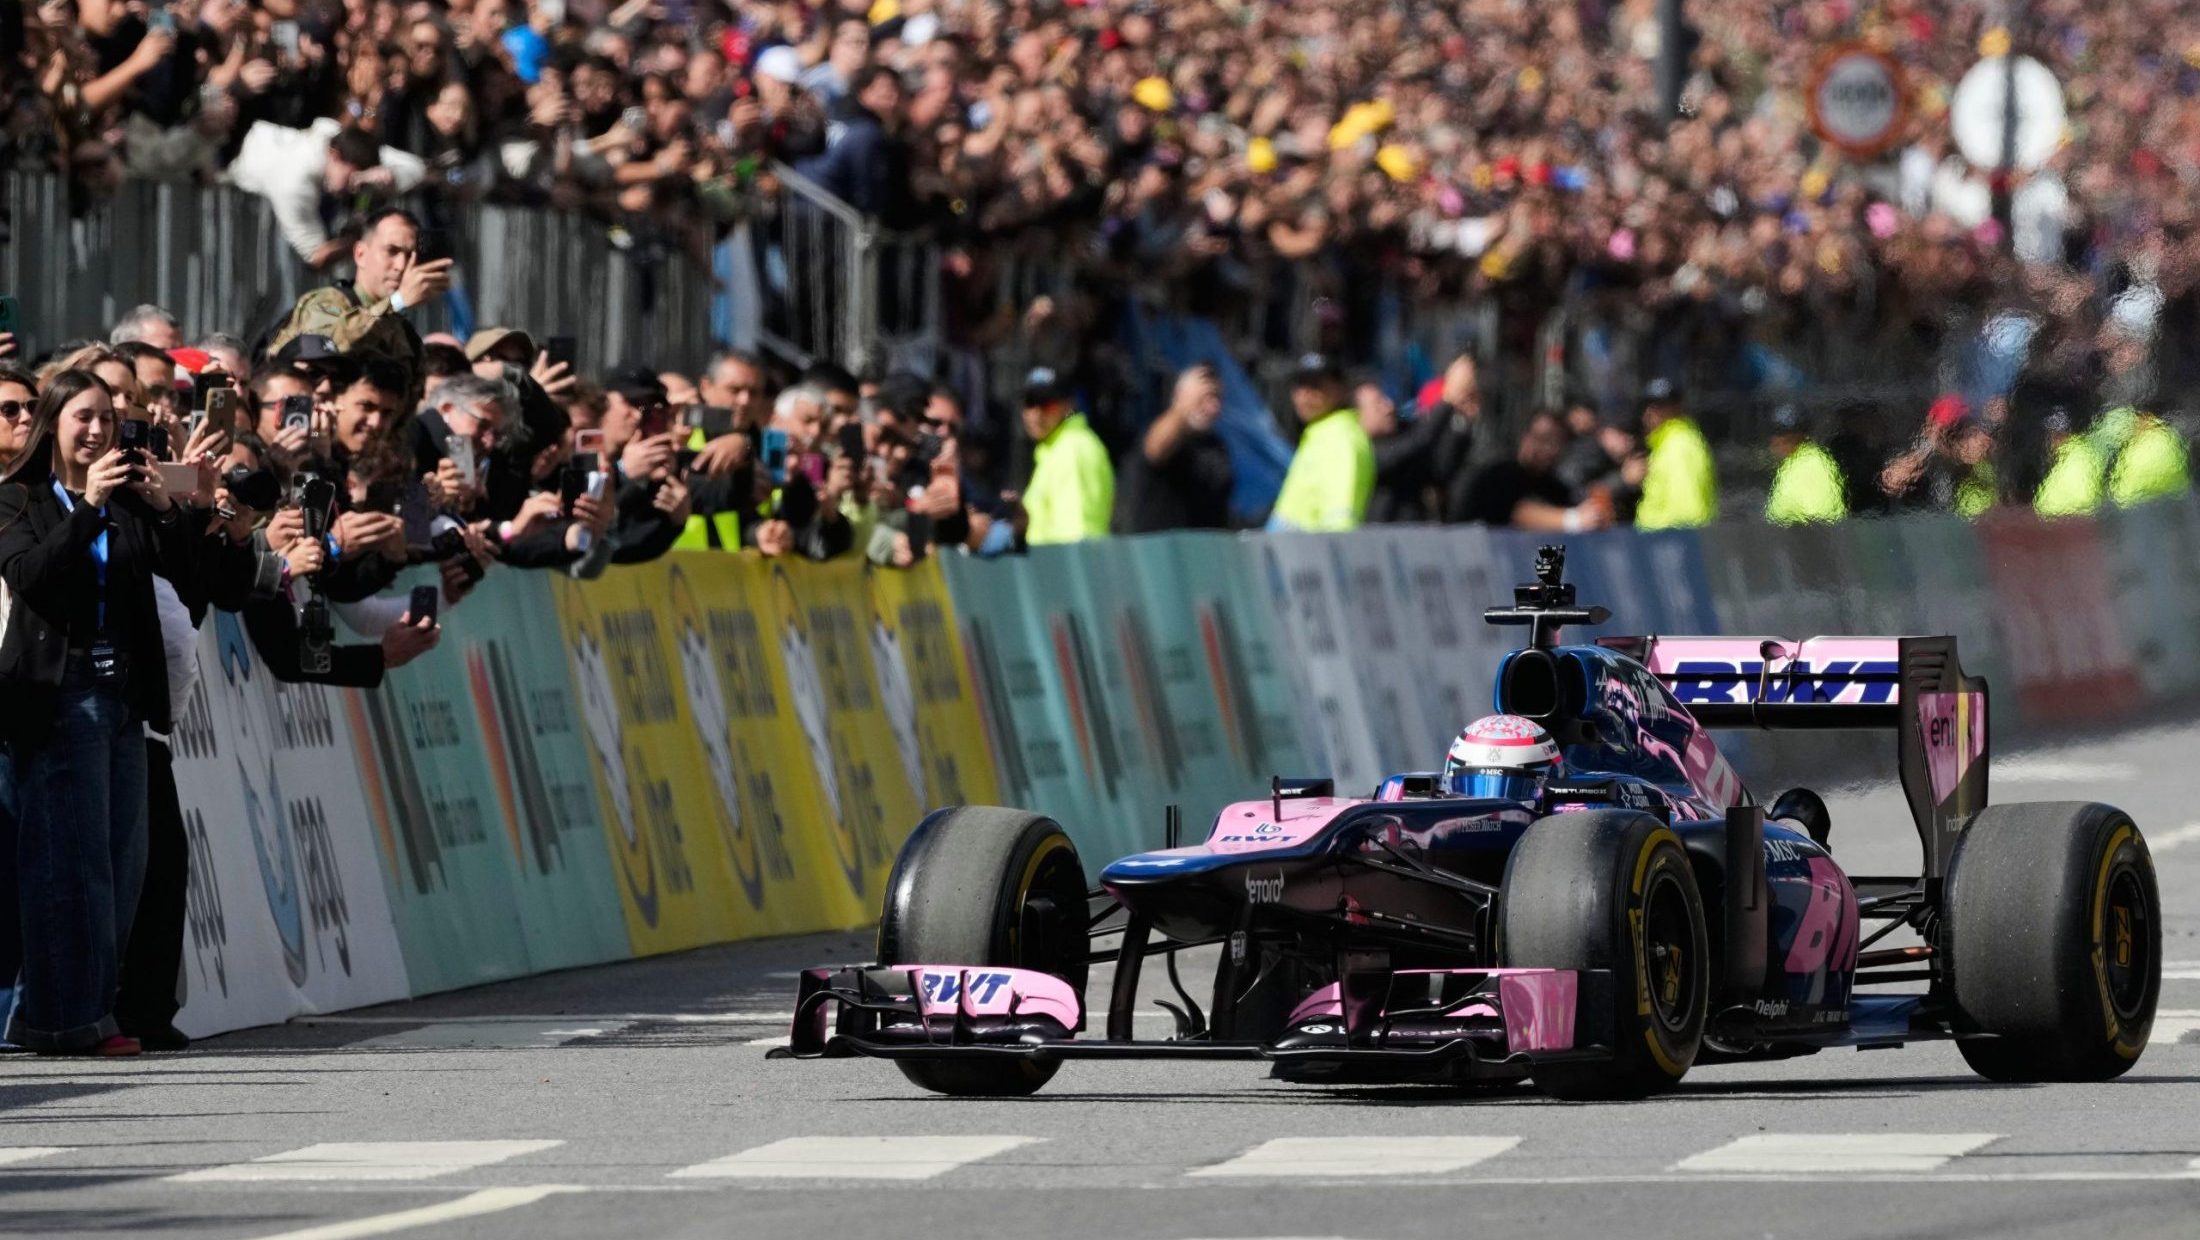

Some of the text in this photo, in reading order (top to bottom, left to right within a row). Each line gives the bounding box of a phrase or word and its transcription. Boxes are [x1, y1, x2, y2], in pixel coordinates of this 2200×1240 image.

[1672, 661, 1898, 703] BWT
[1930, 704, 1955, 747] eni
[1768, 840, 1801, 862] MSC
[923, 973, 1012, 1005] BWT
[1755, 999, 1790, 1019] Delphi
